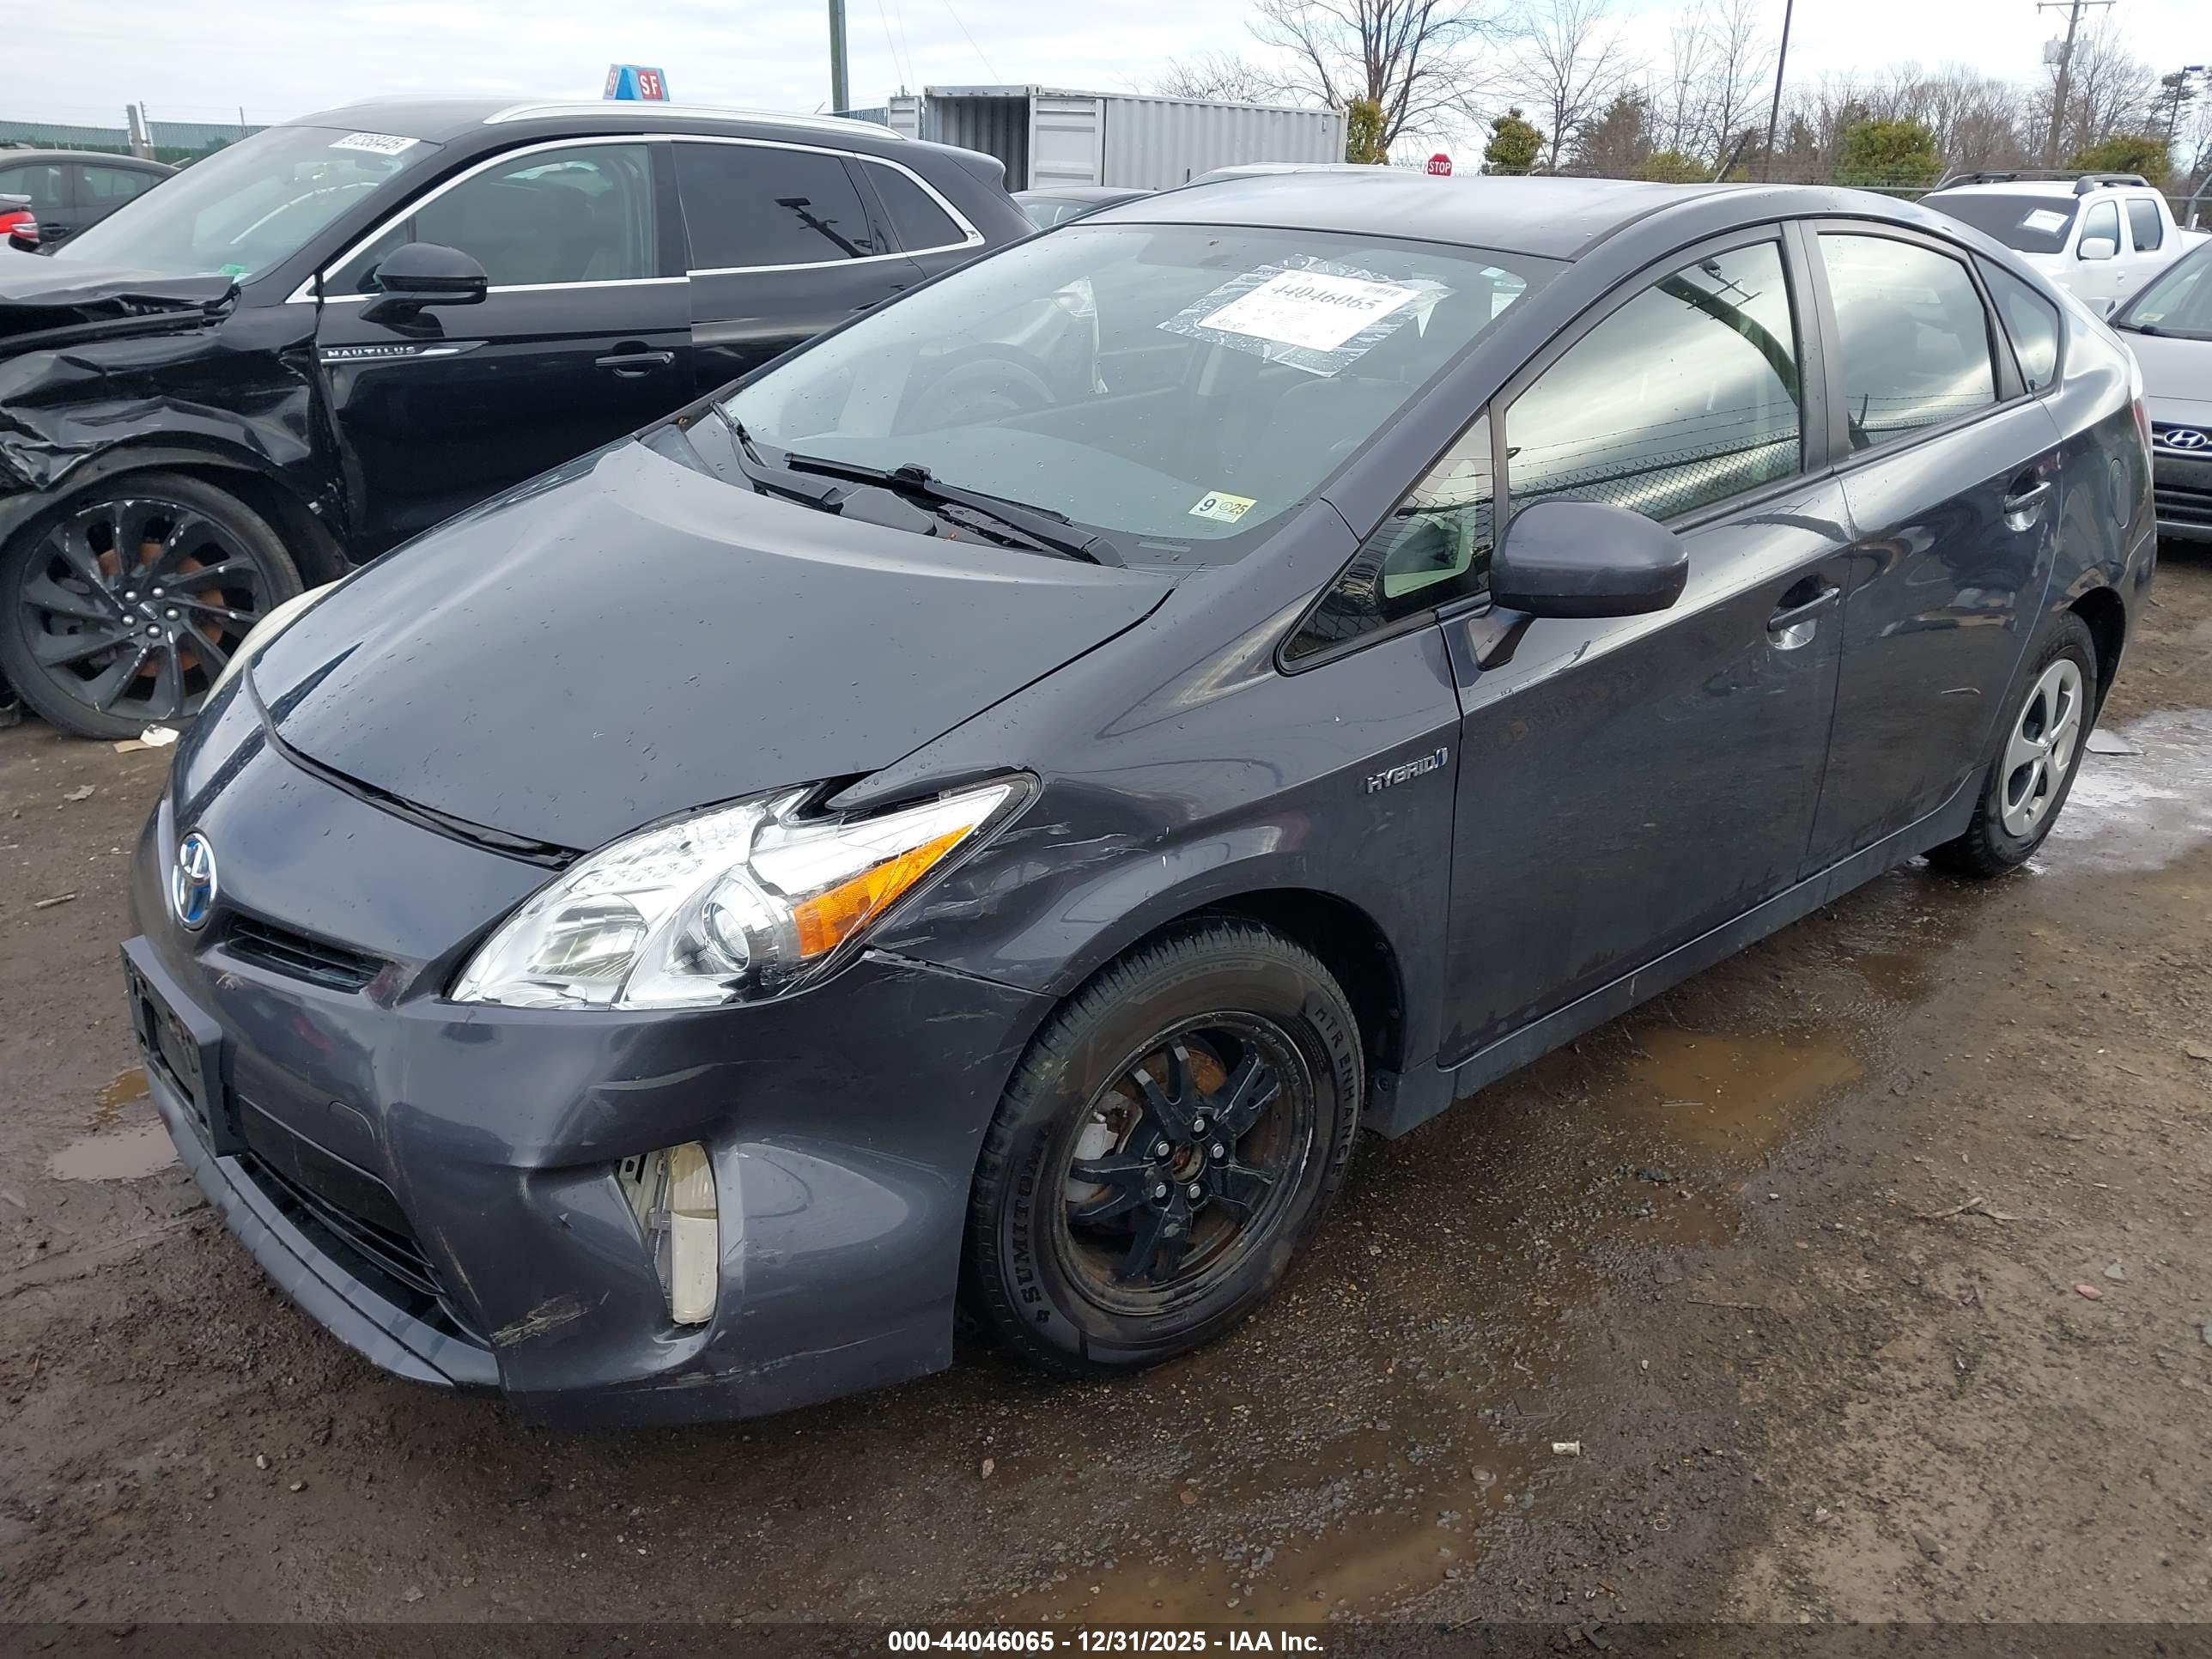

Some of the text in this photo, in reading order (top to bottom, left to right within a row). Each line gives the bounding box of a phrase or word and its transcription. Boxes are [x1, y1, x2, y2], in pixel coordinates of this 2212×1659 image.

[640, 75, 658, 94] SF
[1428, 161, 1451, 173] STOP
[1271, 283, 1382, 311] 44046065
[327, 346, 416, 357] NAUTILUS
[1199, 498, 1249, 515] 9 25
[1366, 754, 1437, 794] HYBRID
[1315, 1007, 1344, 1049] HTR
